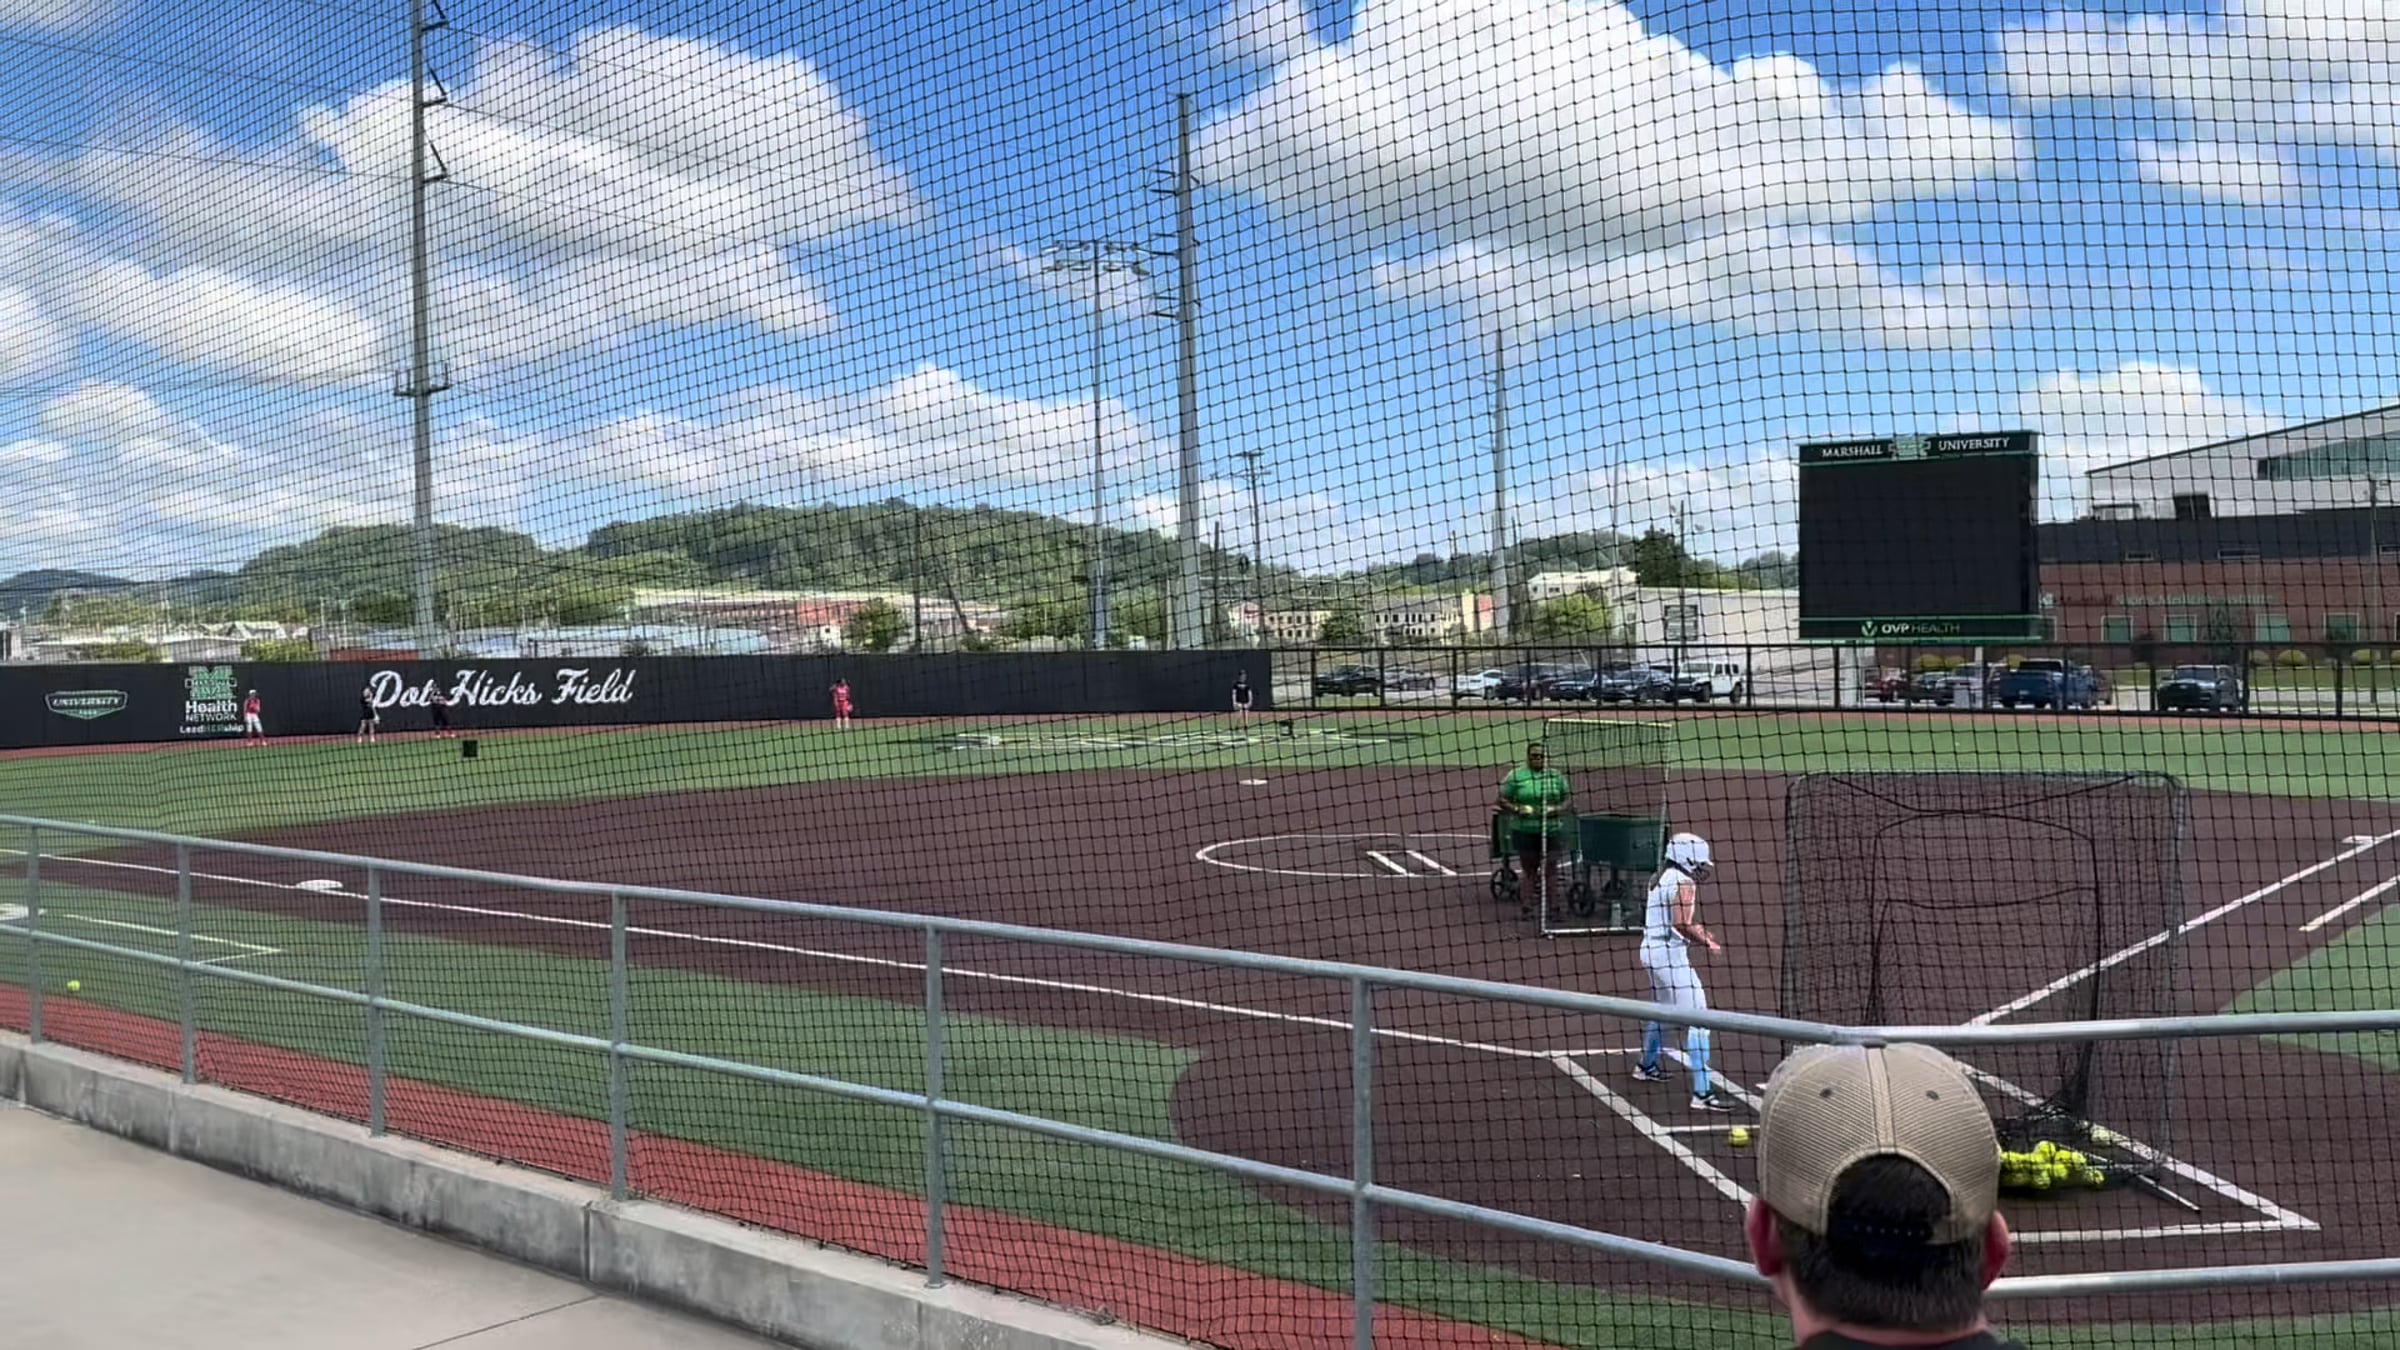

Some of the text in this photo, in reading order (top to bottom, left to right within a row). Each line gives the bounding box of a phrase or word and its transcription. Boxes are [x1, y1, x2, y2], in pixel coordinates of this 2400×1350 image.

[1821, 444, 1883, 458] MARSHALL
[1938, 437, 2010, 451] UNIVERSITY
[1881, 623, 1960, 634] OVP HEALTH
[369, 668, 636, 708] Dot Hicks Field
[52, 696, 121, 707] UNIVERSITY
[185, 699, 238, 713] Health
[185, 712, 237, 722] NETWORK
